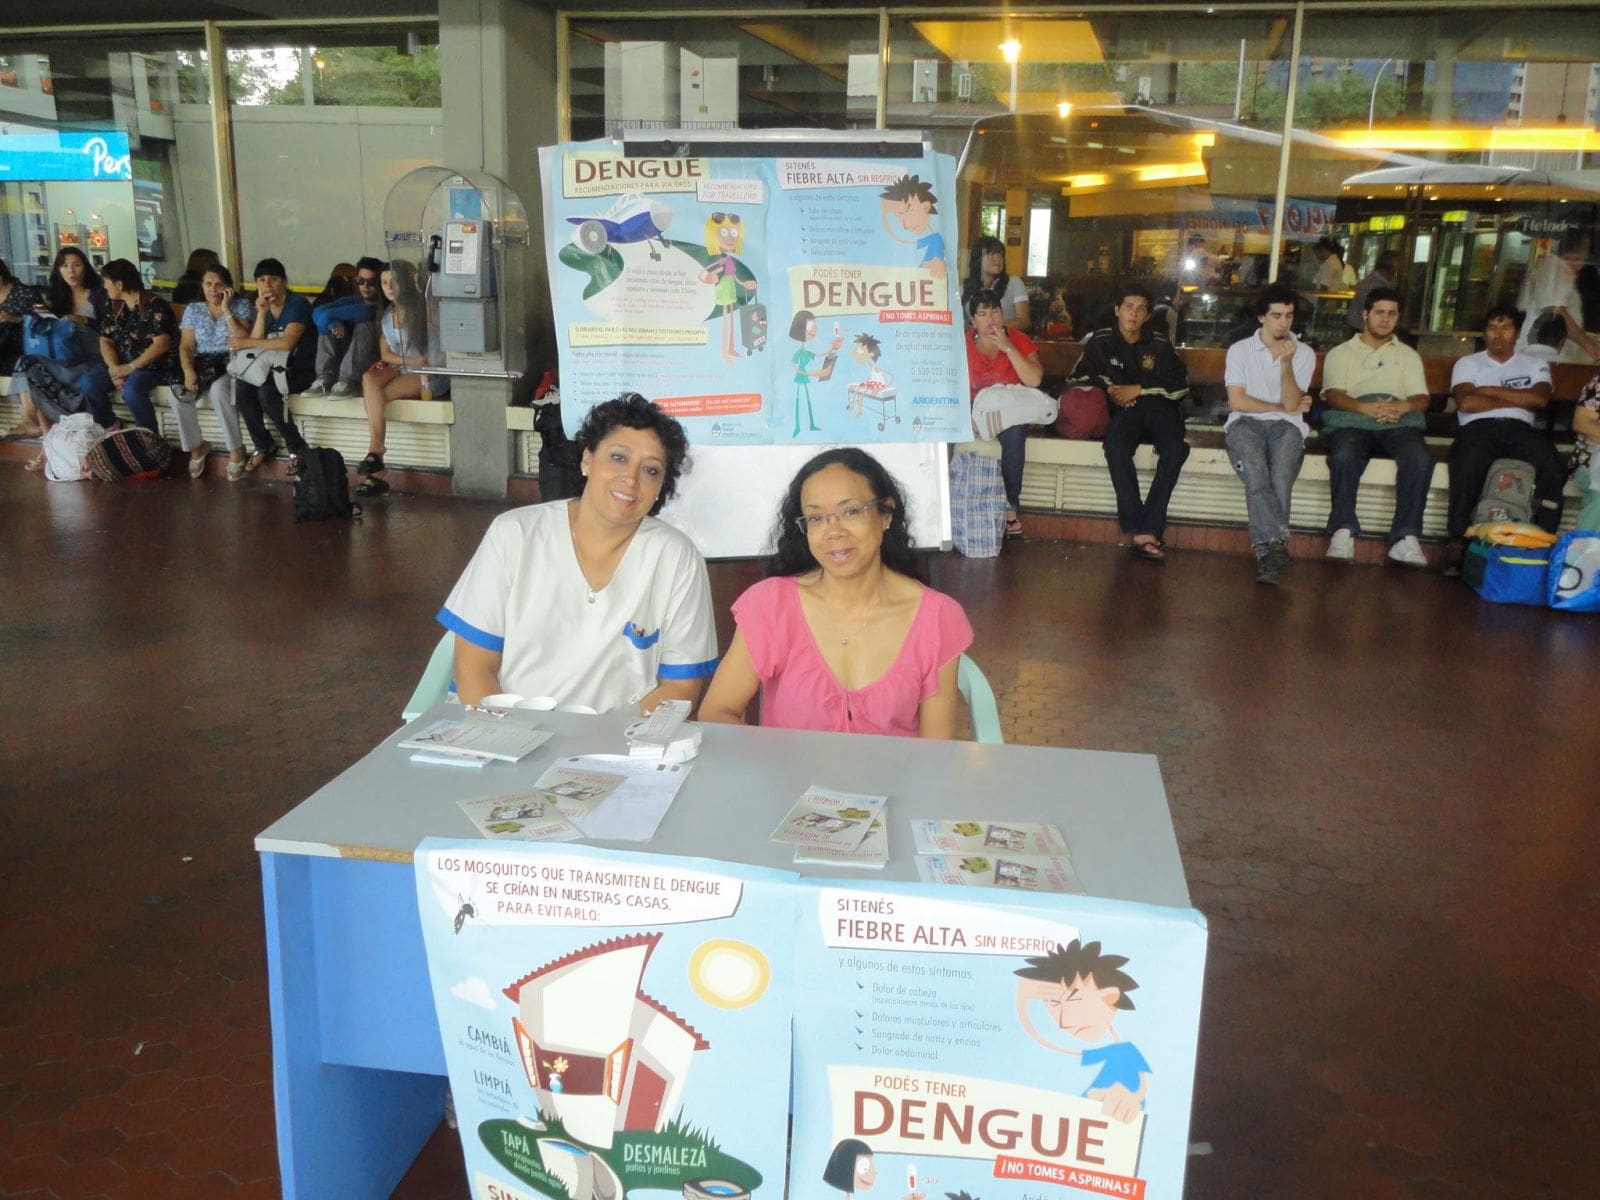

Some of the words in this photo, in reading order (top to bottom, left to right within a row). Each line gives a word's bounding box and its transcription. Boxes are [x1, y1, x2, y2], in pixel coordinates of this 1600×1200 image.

[574, 159, 702, 184] DENGUE
[786, 172, 823, 185] FIEBRE
[826, 172, 855, 184] ALTA
[857, 174, 870, 184] SIN
[574, 183, 639, 194] RECOMENDACIONES
[641, 181, 659, 190] PARA
[662, 180, 692, 188] VIAJEROS
[813, 268, 838, 279] PODÉS
[840, 269, 862, 279] TENER
[802, 279, 935, 309] DENGUE
[912, 396, 960, 405] ARGENTINA
[437, 857, 461, 872] LOS
[464, 860, 538, 879] MOSQUITOS
[541, 867, 565, 882] QUE
[569, 869, 651, 890] TRANSMITEN
[653, 877, 667, 891] EL
[670, 878, 722, 896] DENGUE
[485, 881, 499, 894] SE
[503, 880, 540, 897] CRÍAN
[543, 886, 558, 899] EN
[562, 887, 622, 906] NUESTRAS
[626, 894, 672, 912] CASAS.
[837, 898, 849, 912] SI
[852, 898, 895, 915] TENÉS
[497, 901, 534, 916] PARA
[537, 904, 601, 922] EVITARLO:
[837, 918, 905, 943] FIEBRE
[913, 925, 967, 948] ALTA
[974, 934, 997, 949] SIN
[1001, 936, 1056, 952] RESFRÍO
[838, 957, 845, 969] y
[847, 955, 885, 971] algunos
[887, 960, 899, 973] de
[901, 963, 926, 975] estos
[872, 982, 894, 994] Dolor
[896, 984, 907, 995] de
[908, 986, 938, 998] cabeza
[872, 1012, 902, 1024] Dolores
[904, 1015, 950, 1028] musculares
[951, 1020, 957, 1030] y
[959, 1019, 1003, 1033] articulares
[467, 1025, 511, 1057] CAMBIÁ
[871, 1028, 911, 1042] Sangrado
[912, 1032, 923, 1043] de
[925, 1034, 946, 1044] nariz
[947, 1037, 953, 1046] y
[871, 1044, 893, 1056] Dolor
[895, 1047, 938, 1060] abdominal
[473, 1069, 513, 1097] LIMPIÁ
[873, 1075, 920, 1093] PODÉS
[925, 1079, 967, 1099] TENER
[853, 1090, 1110, 1166] DENGUE
[500, 1129, 530, 1156] TAPÁ
[623, 1143, 707, 1168] DESMALEZÁ
[625, 1164, 646, 1177] patios
[647, 1165, 653, 1175] y
[653, 1164, 681, 1176] jardines
[1001, 1159, 1024, 1174] ¡NO
[1027, 1163, 1065, 1181] TOMES
[1068, 1170, 1138, 1197] ASPIRINAS!
